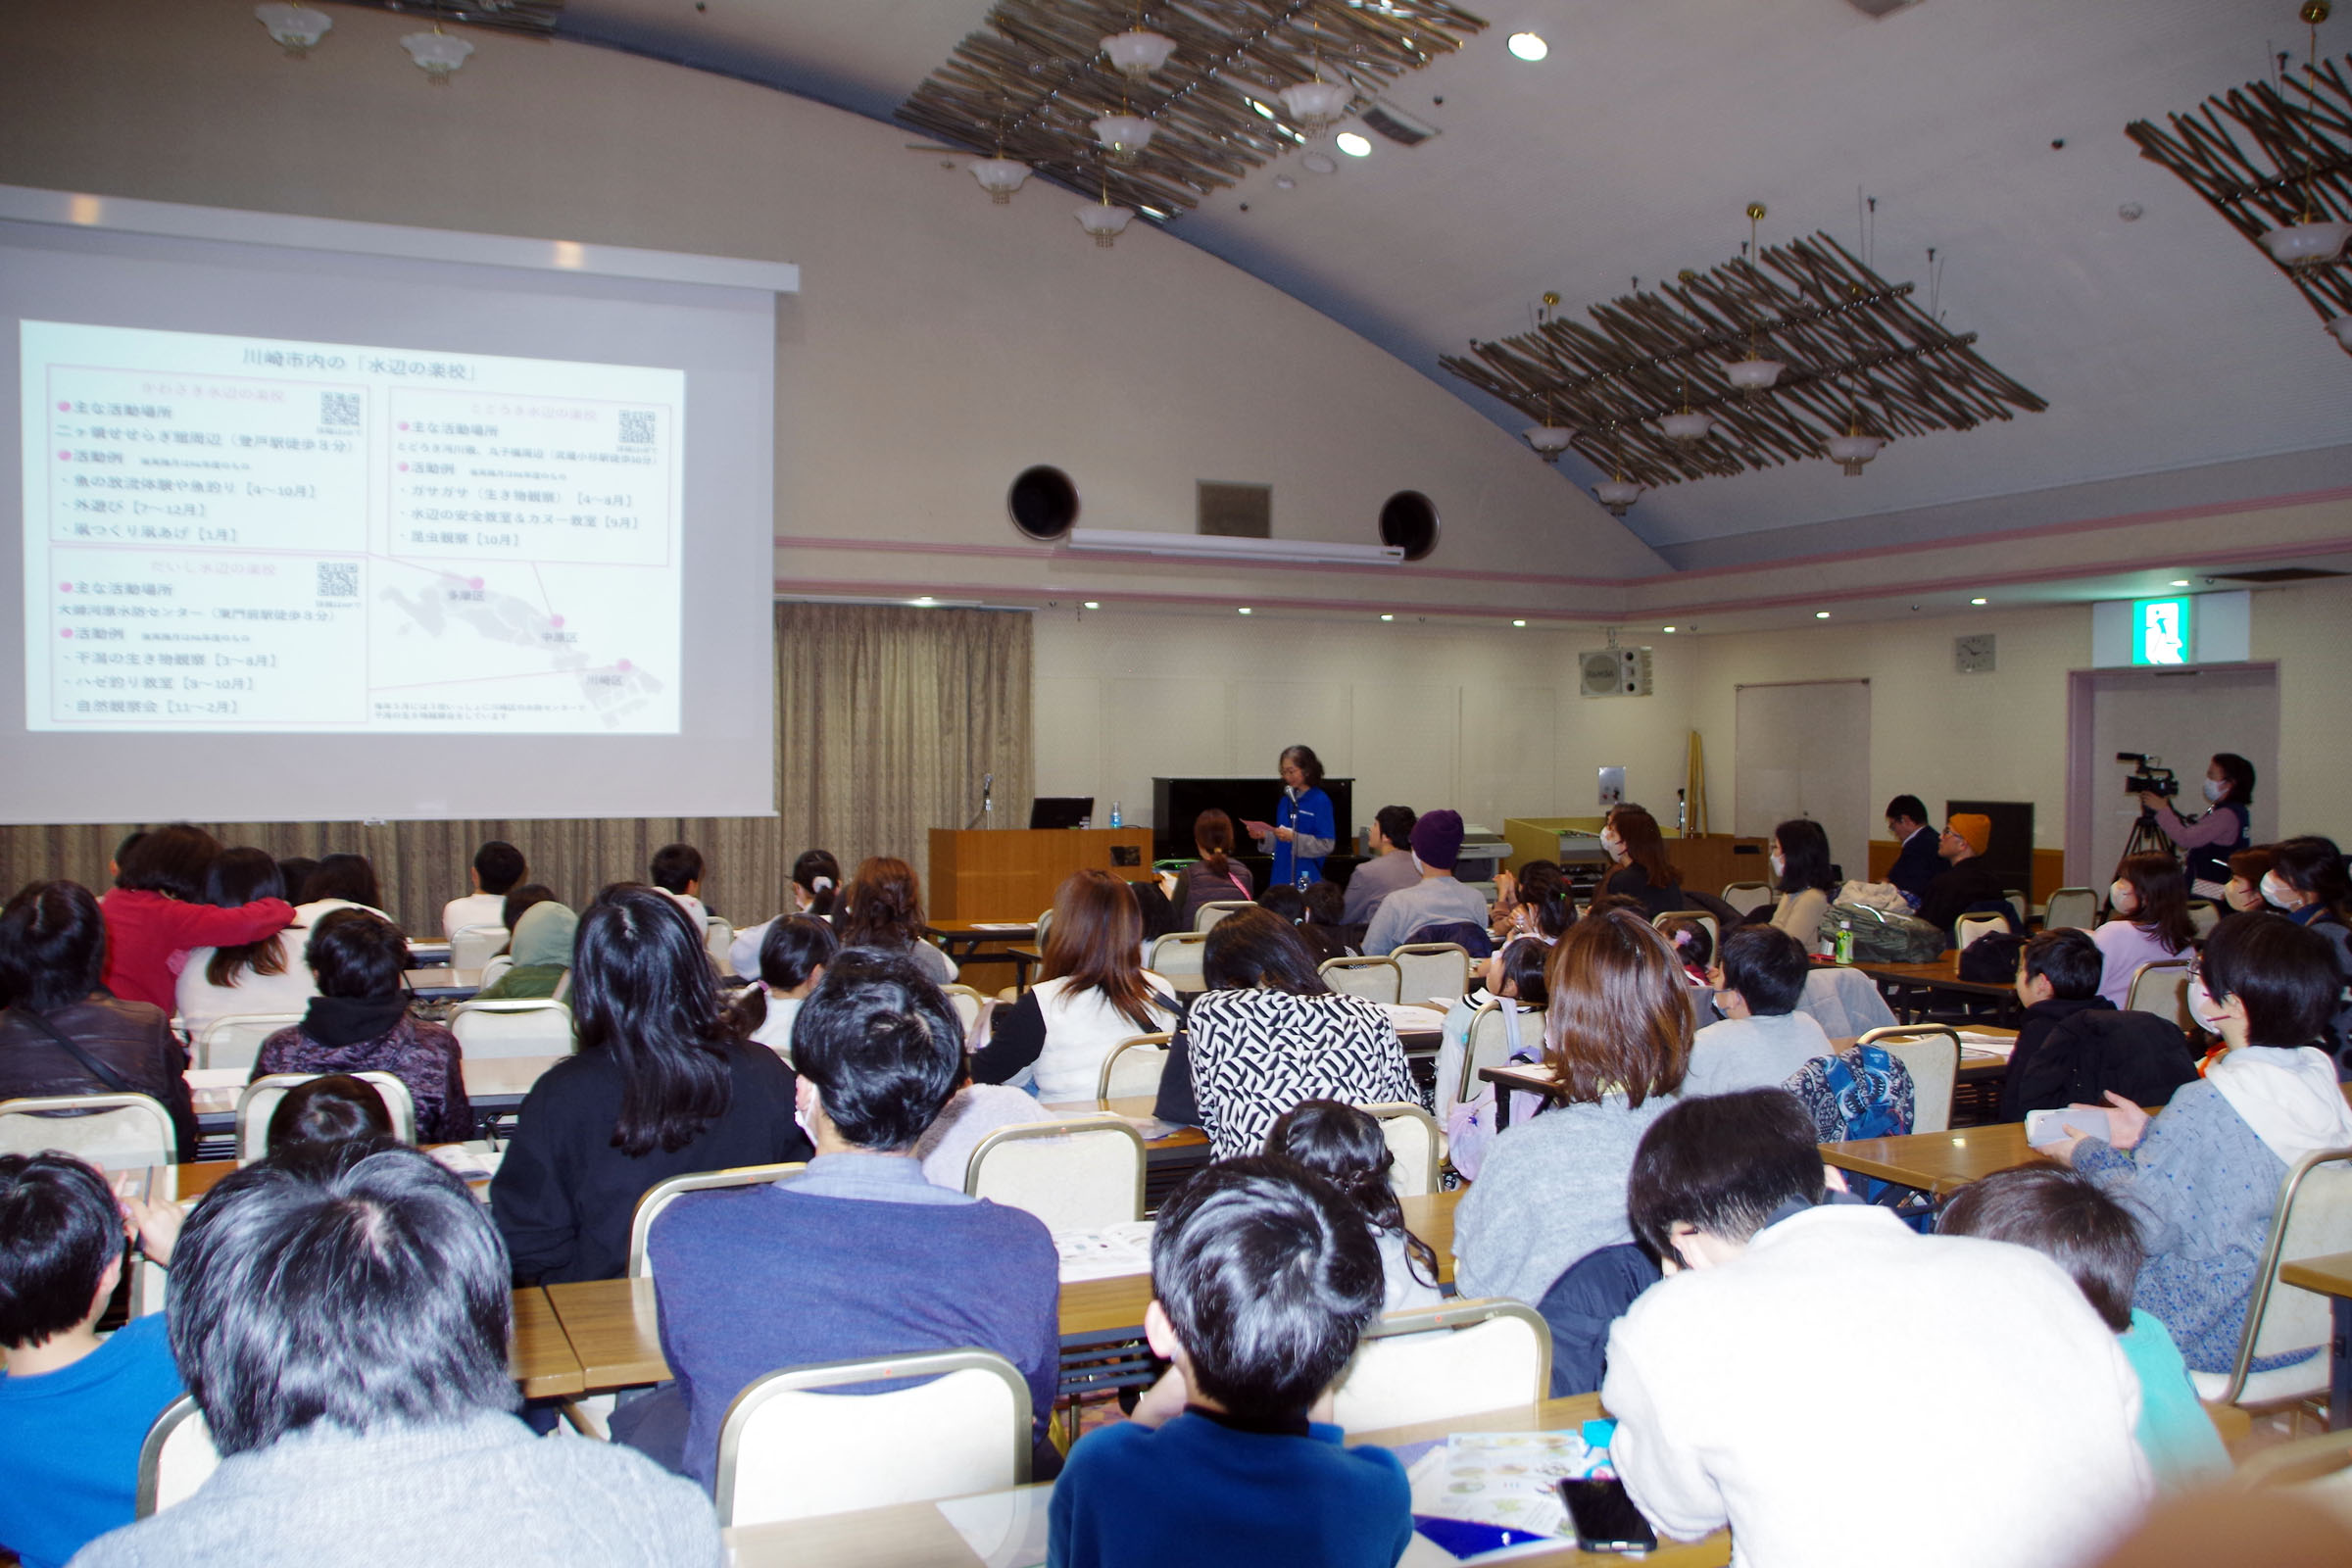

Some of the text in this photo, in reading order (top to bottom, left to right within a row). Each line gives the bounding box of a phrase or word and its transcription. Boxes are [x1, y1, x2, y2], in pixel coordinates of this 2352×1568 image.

[242, 347, 477, 380] 川崎市内の「水辺の楽校」
